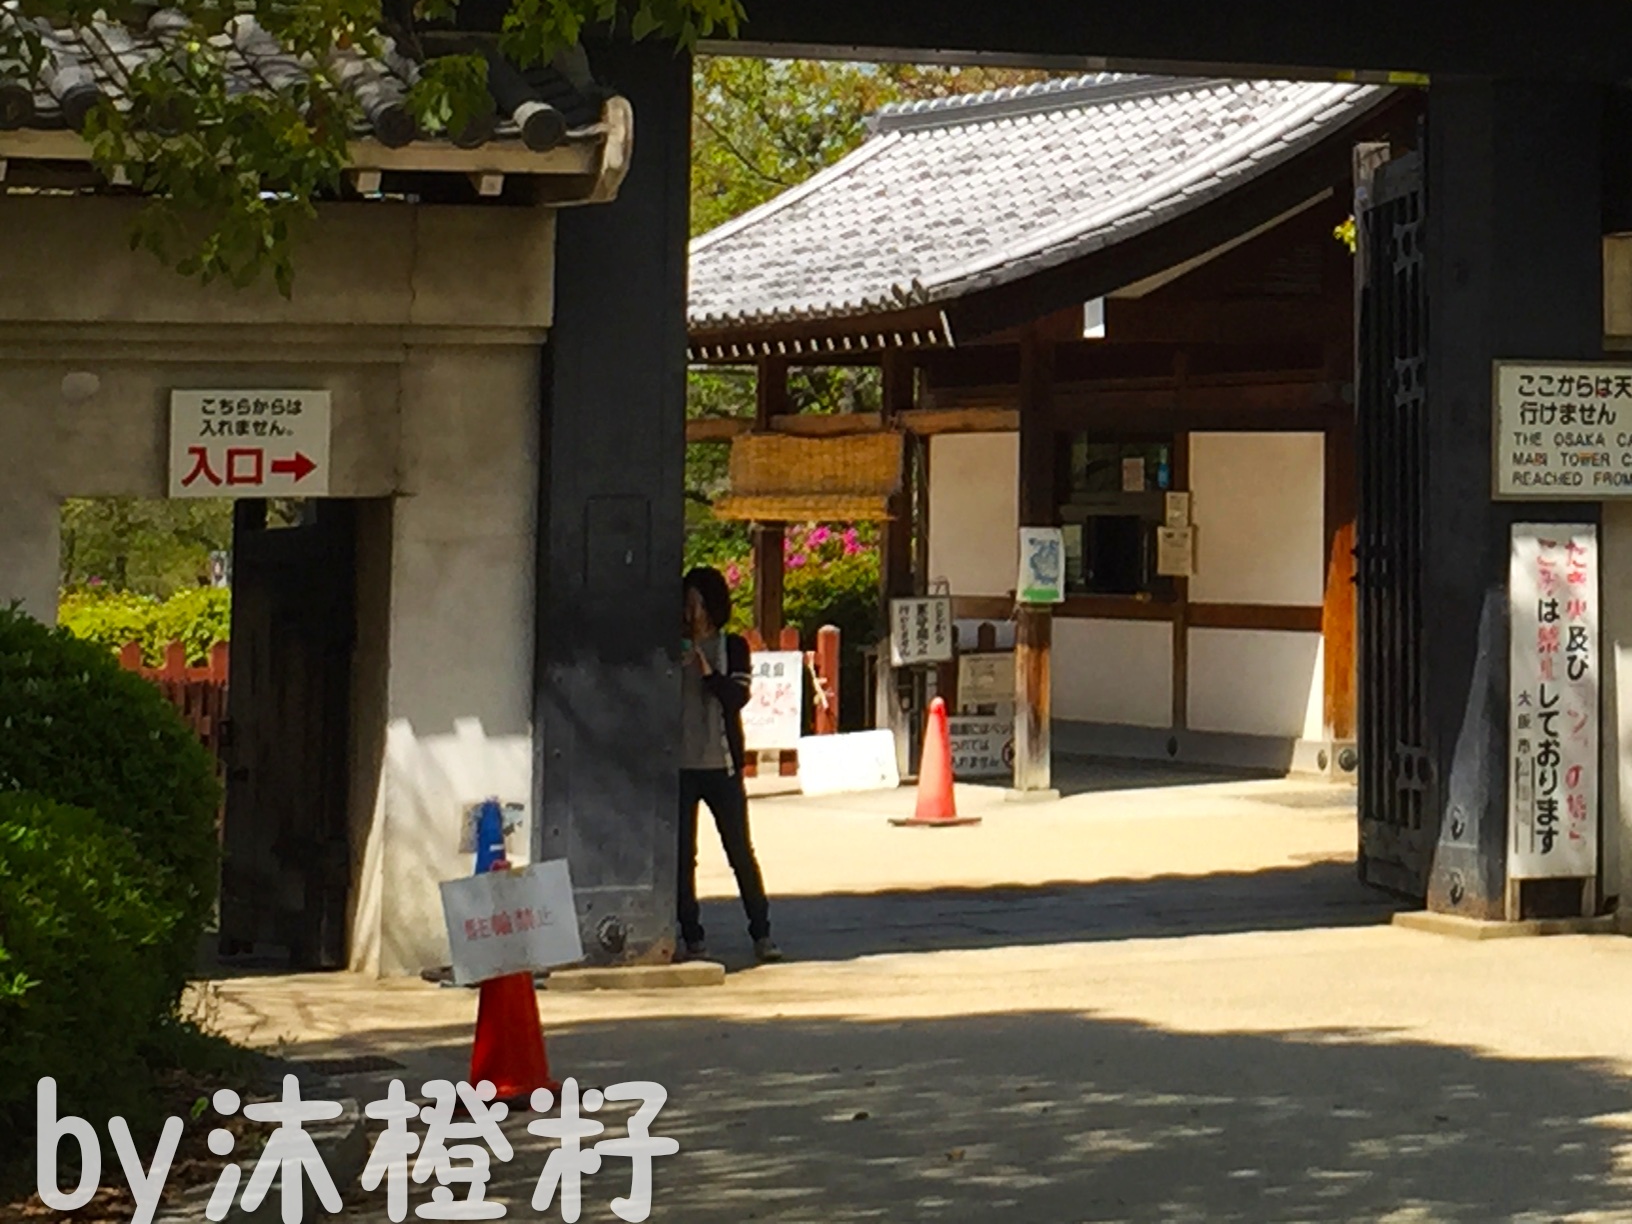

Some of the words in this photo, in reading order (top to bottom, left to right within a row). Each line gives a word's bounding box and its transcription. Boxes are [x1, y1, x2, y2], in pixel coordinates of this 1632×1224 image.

[201, 398, 302, 415] こちらからは
[1520, 402, 1616, 425] 行けません
[1513, 432, 1542, 446] THE
[1553, 432, 1605, 447] OSAKA
[181, 445, 264, 487] 入口
[1512, 452, 1547, 466] MAIN
[1561, 452, 1610, 466] TOWER
[1512, 472, 1583, 486] REACHED
